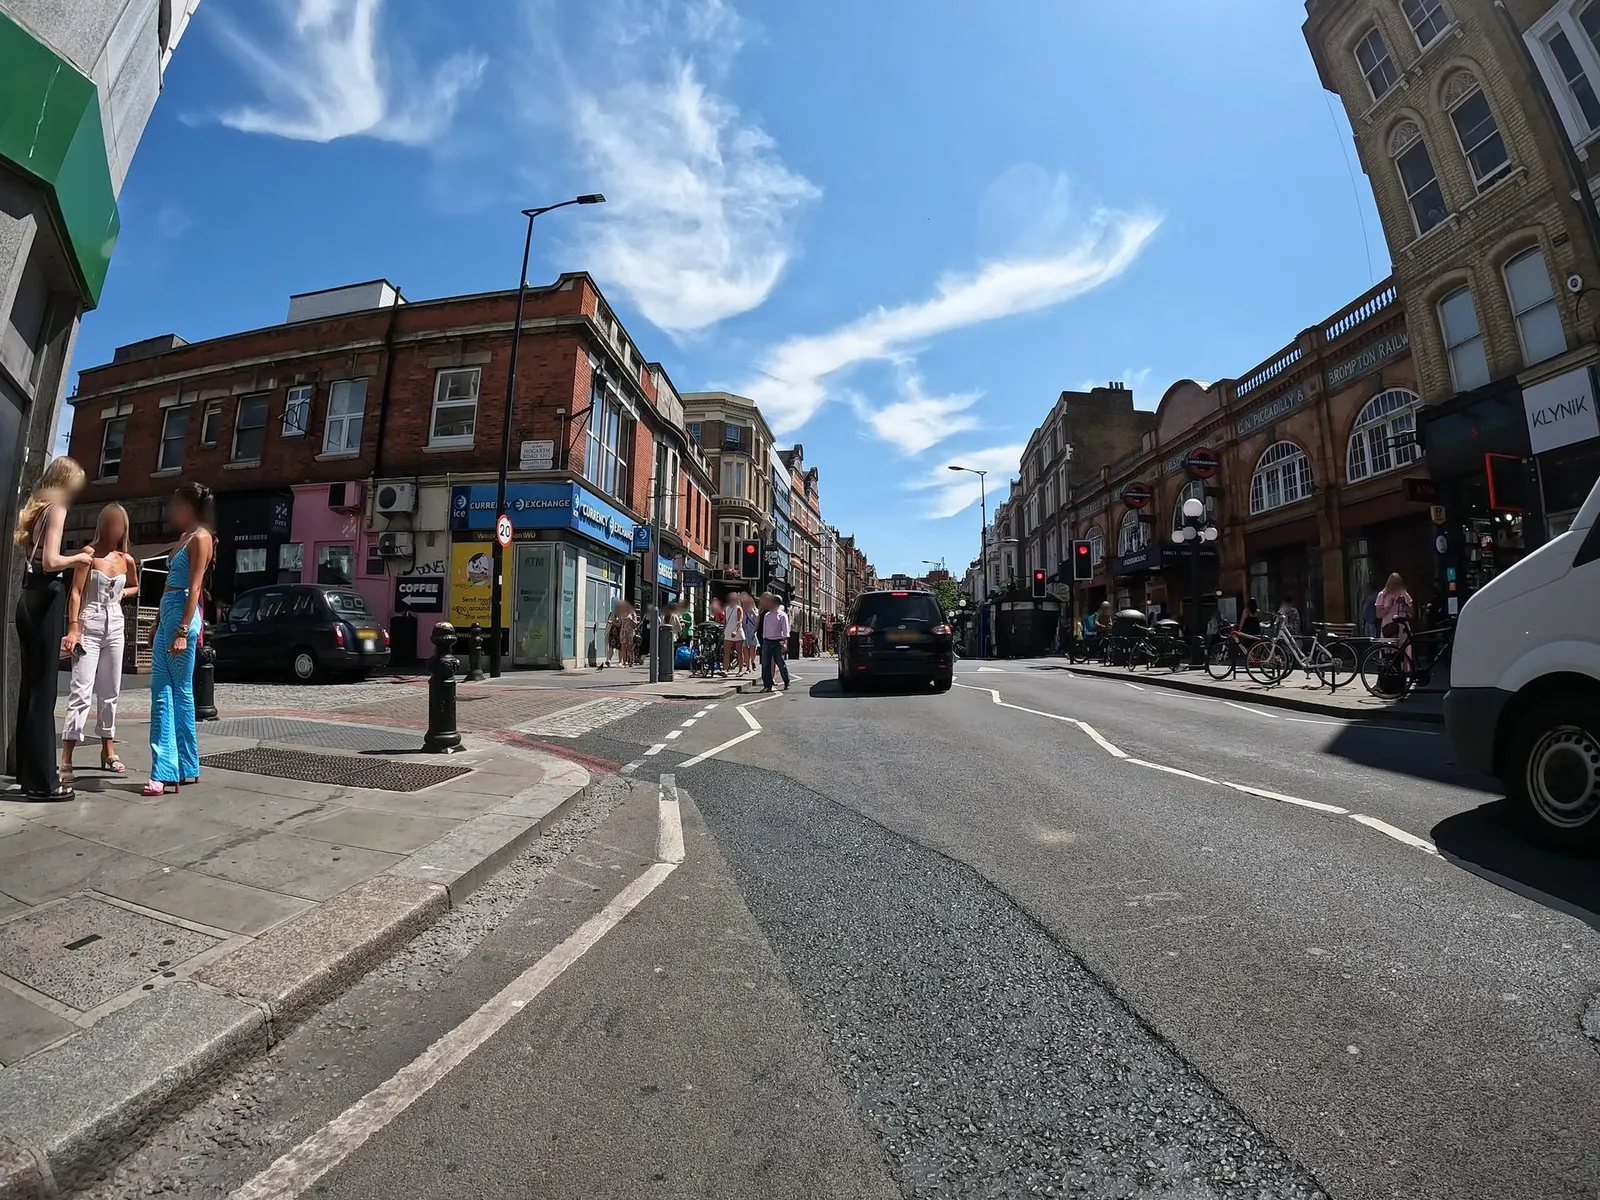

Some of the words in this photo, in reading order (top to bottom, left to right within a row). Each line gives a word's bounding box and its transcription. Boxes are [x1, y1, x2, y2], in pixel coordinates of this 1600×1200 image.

[1328, 350, 1376, 385] BROMPTON
[1253, 394, 1294, 426] PICCADILLY
[1297, 390, 1304, 402] &
[470, 501, 512, 509] CURREY
[525, 500, 570, 508] EXCHANGE
[453, 509, 466, 517] ice
[583, 504, 608, 527] CURRENCY
[614, 522, 634, 540] EXCHANG
[500, 524, 510, 537] 20
[524, 557, 544, 567] ATM
[399, 583, 439, 593] COFFEE
